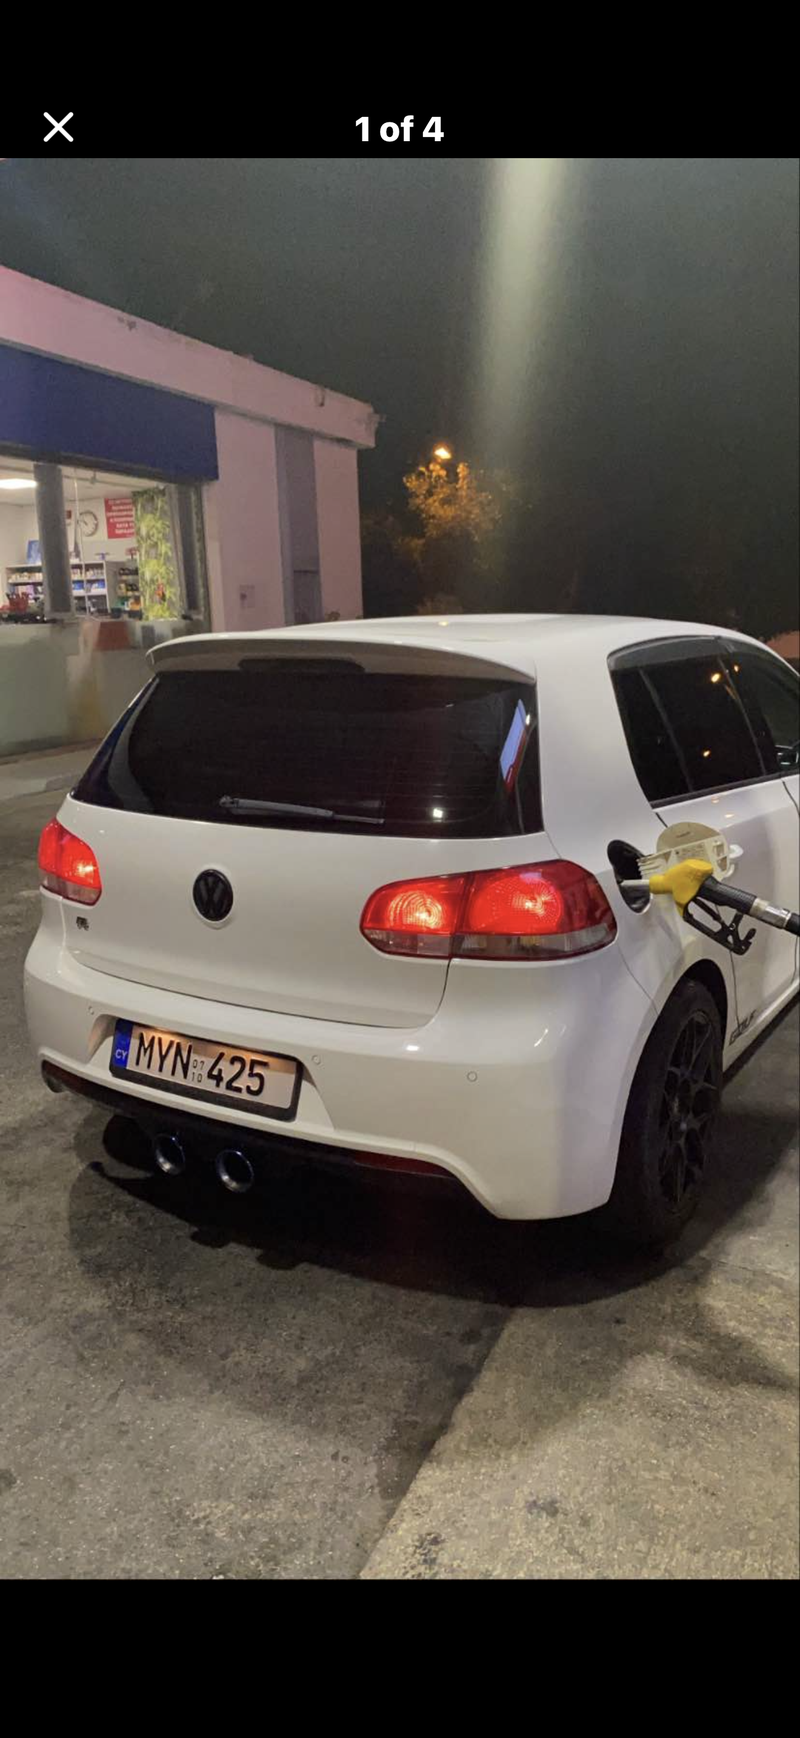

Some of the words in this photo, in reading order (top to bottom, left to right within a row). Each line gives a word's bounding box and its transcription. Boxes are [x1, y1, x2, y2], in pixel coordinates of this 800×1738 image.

[115, 1049, 128, 1060] CY
[135, 1032, 192, 1080] MYN
[207, 1052, 269, 1096] 425
[192, 1059, 205, 1070] 07
